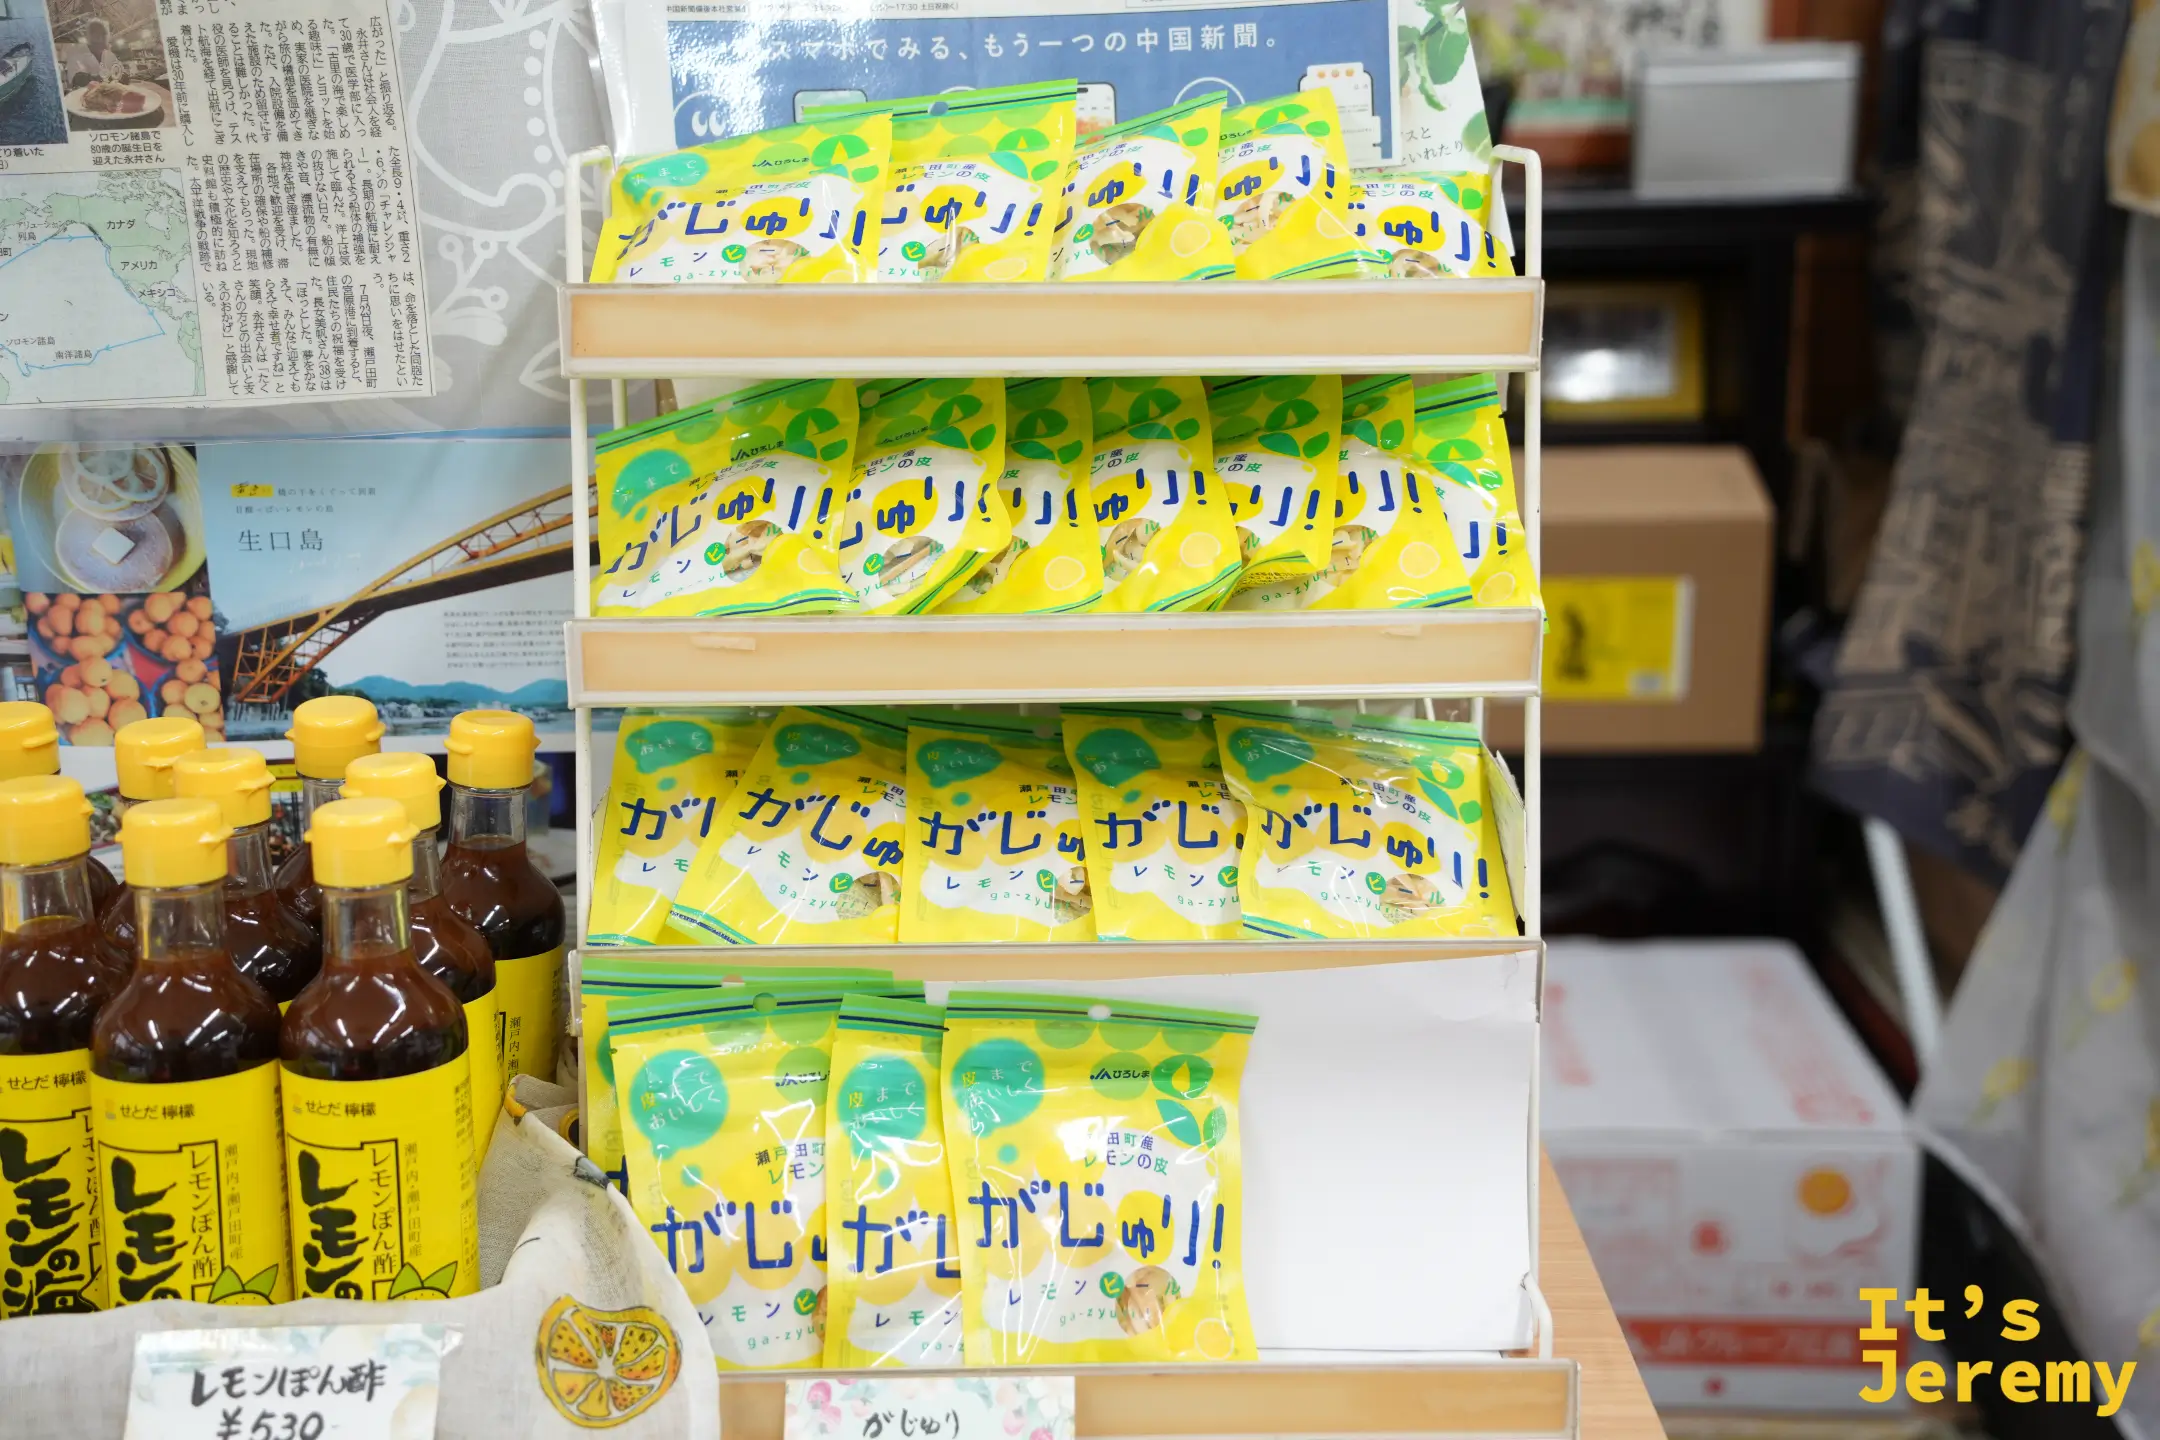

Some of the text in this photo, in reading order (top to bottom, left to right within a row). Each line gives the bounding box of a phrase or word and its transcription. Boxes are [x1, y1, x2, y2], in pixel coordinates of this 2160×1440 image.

[180, 25, 197, 63] 着けた。
[198, 24, 226, 145] ト航海を経て出航にこぎ
[212, 23, 242, 144] 役の医師を見つけ、テス
[228, 22, 257, 144] ることは難しかった。代
[244, 22, 272, 142] えた施設のため留守にす
[260, 21, 288, 142] た。ただ、入院設備を備
[275, 20, 303, 141] がら旅の構想を温めてき
[291, 20, 319, 141] め、実家の医院を継ぎな
[308, 19, 336, 140] る趣味に」とヨットを始
[323, 18, 350, 139] た。「古里の海で楽しめ
[338, 18, 366, 137] て30歳で医学部に入っ
[356, 27, 382, 138] 永井さんは社会人を経
[370, 16, 397, 131] 広がった」と振り返る。
[768, 22, 1277, 61] スマホでみる、もう一つの中国新聞。
[89, 130, 161, 142] ソロモン諸島で
[90, 142, 163, 154] 80歳の誕生日を
[92, 155, 165, 166] 迎えた永井さん
[106, 218, 136, 231] カナダ
[186, 155, 211, 272] た。太平洋戦争の戦跡で
[202, 155, 228, 272] 史料館も積極的に訪ね
[218, 154, 243, 271] の歴史や文化を知ろうと
[233, 153, 259, 270] を支えてもらった。現地
[249, 152, 274, 270] 在場所の確保や船の補修
[266, 162, 290, 269] 各地で歓迎を受け、滞
[280, 151, 302, 252] 神経を研ぎ澄ました。
[296, 150, 320, 267] きや音、漂流物の有無に
[311, 150, 336, 267] の抜けない日々。船の傾
[326, 149, 351, 266] 施して臨んだ。洋上は気
[343, 149, 365, 265] られるよう船体の補強を
[121, 260, 158, 271] アメリカ
[138, 288, 176, 298] メキシコ
[202, 281, 217, 307] いる。
[373, 273, 385, 289] う。
[6, 336, 56, 347] ソロモン諸島
[55, 350, 93, 360] 南洋諸島
[218, 280, 240, 395] えのおかげ」と感謝して
[234, 279, 256, 395] さんの方との出会いと支
[249, 279, 270, 394] 笑顔。永井さんは「たく
[265, 278, 285, 393] らえて幸せ者ですね」と
[280, 278, 301, 392] えて、みんなに迎えても
[296, 281, 317, 392] 「ほっとした。夢をかな
[326, 276, 347, 390] 住民たちの祝福を受け
[341, 275, 363, 383] の宮原港に到着すると、
[388, 273, 409, 386] ちに思いをはせたとい
[403, 272, 423, 386] は、命を落とした同胞た
[238, 528, 323, 551] 生口島
[604, 477, 834, 574] がじゅり!
[642, 857, 690, 873] レモ
[738, 787, 904, 866] がじゅ
[848, 1081, 917, 1108] 皮まで
[962, 1060, 1033, 1087] 皮まで
[1089, 1067, 1151, 1081] JAひろしま
[188, 1150, 216, 1280] レモンぽん酢
[224, 1143, 243, 1261] 瀬戸内・瀬戸田町産
[369, 1147, 397, 1277] レモンぽん酢
[404, 1143, 423, 1258] 瀬戸内・瀬戸田町産
[769, 1161, 825, 1186] レモン
[1085, 1149, 1169, 1176] レモンの皮
[967, 1179, 1225, 1270] がじゅり!
[1008, 1271, 1182, 1306] レモンピール
[191, 1358, 388, 1408] レモンぽん酢
[862, 1408, 960, 1439] がじゅり
